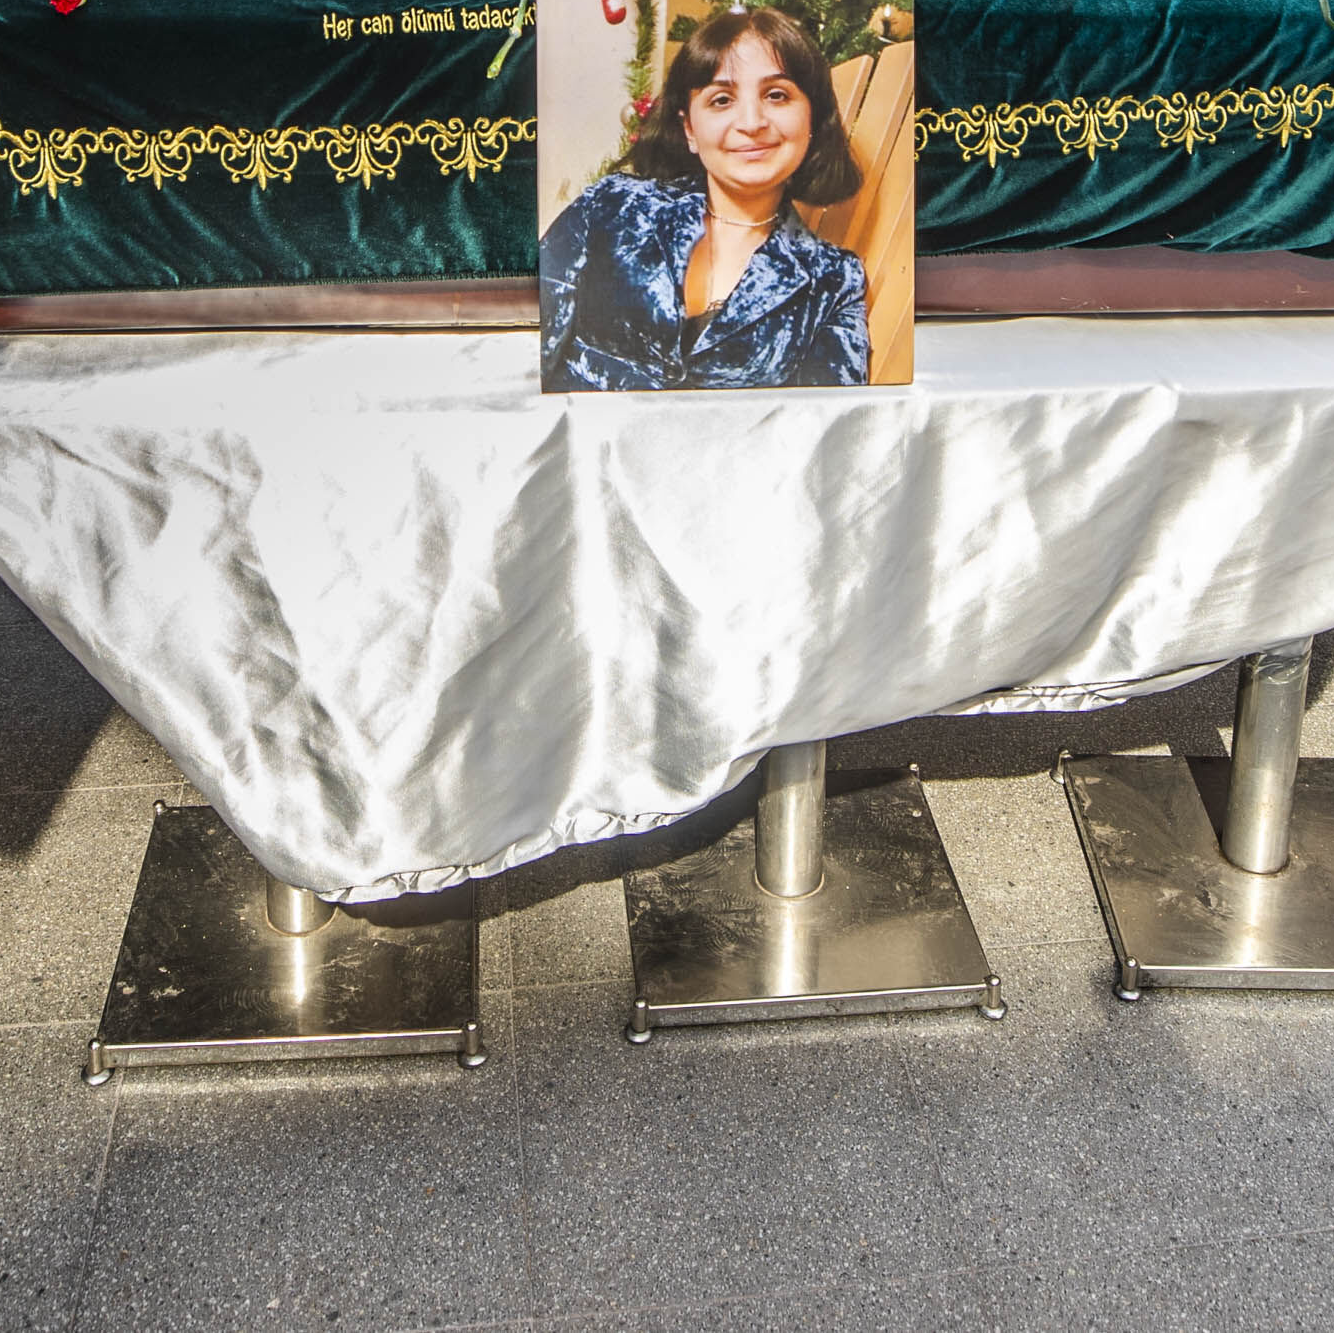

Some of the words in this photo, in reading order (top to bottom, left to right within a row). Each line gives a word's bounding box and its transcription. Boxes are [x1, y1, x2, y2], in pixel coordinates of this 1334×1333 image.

[323, 11, 354, 41] Her
[361, 13, 394, 35] can
[401, 7, 455, 35] ölümü
